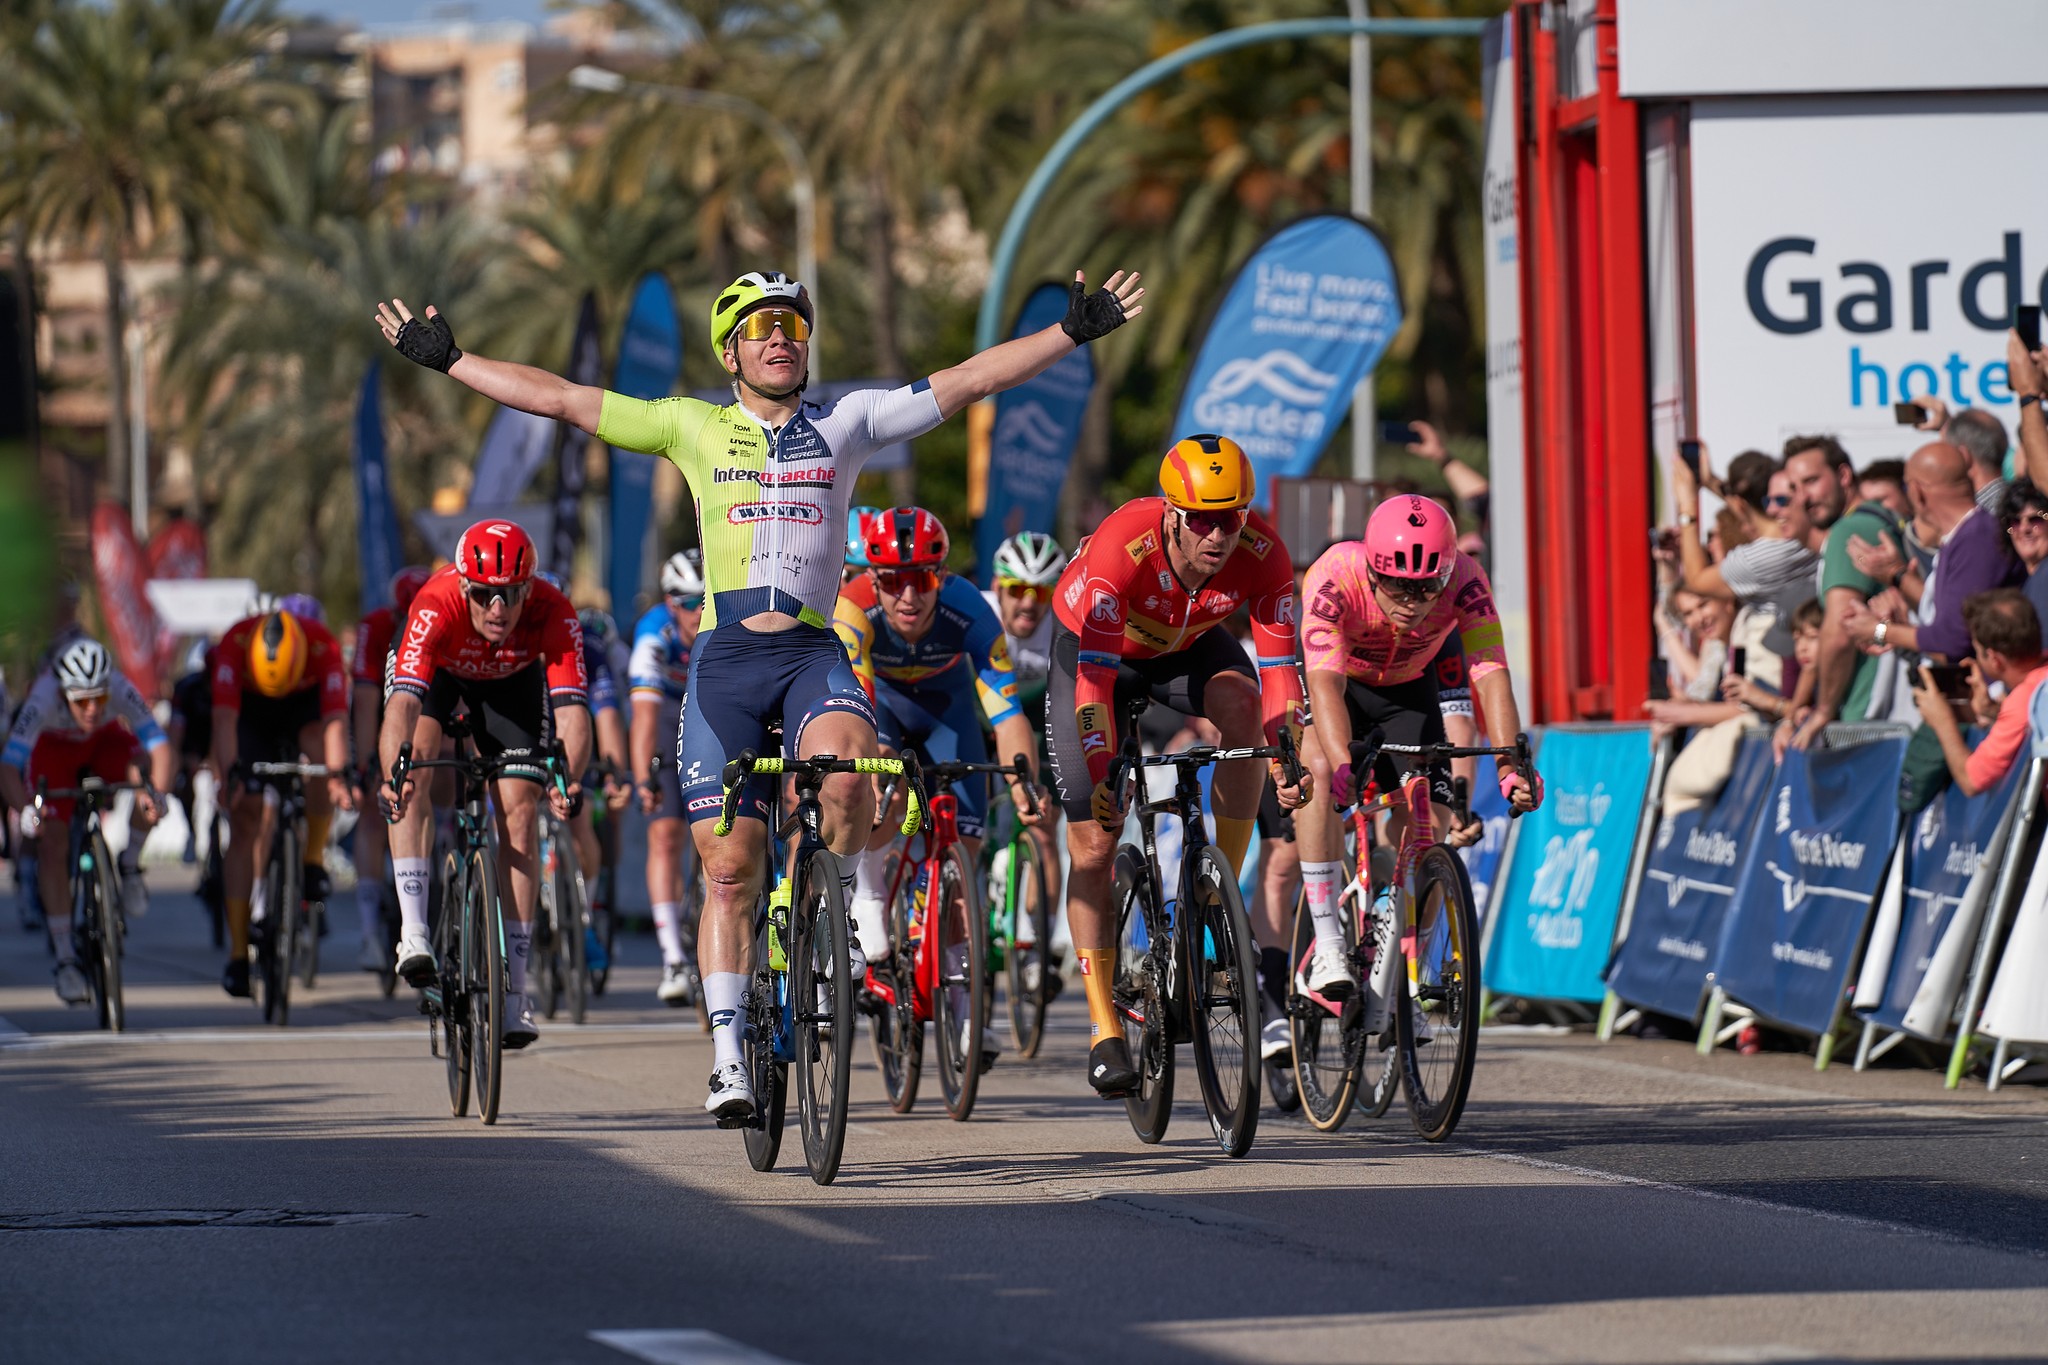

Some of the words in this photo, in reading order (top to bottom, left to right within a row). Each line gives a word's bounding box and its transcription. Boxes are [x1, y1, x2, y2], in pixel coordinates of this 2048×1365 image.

[1744, 232, 2048, 337] Gard
[1849, 346, 2015, 408] hote
[1193, 392, 1327, 439] Garden
[733, 424, 751, 433] TOM
[784, 431, 814, 440] CUBE
[730, 438, 758, 448] uvex
[783, 449, 823, 460] VERGE
[738, 505, 813, 519] WANTY
[1131, 545, 1143, 557] Uno
[1143, 535, 1154, 549] X
[1240, 531, 1254, 544] Uno
[1255, 540, 1268, 552] X
[741, 551, 809, 566] FANTINI
[1374, 553, 1393, 572] EF
[1092, 588, 1121, 624] R
[940, 606, 970, 629] TREK
[401, 608, 438, 675] ARKEA
[564, 618, 588, 687] ARKEA
[1082, 707, 1095, 731] Uno
[1082, 733, 1105, 752] X
[1045, 723, 1071, 801] REITAN
[682, 775, 717, 789] CUBE
[1434, 780, 1455, 803] Rap
[691, 797, 725, 808] WANT
[810, 807, 818, 842] CUBE
[396, 870, 428, 878] ARKEA
[1304, 880, 1334, 904] EF
